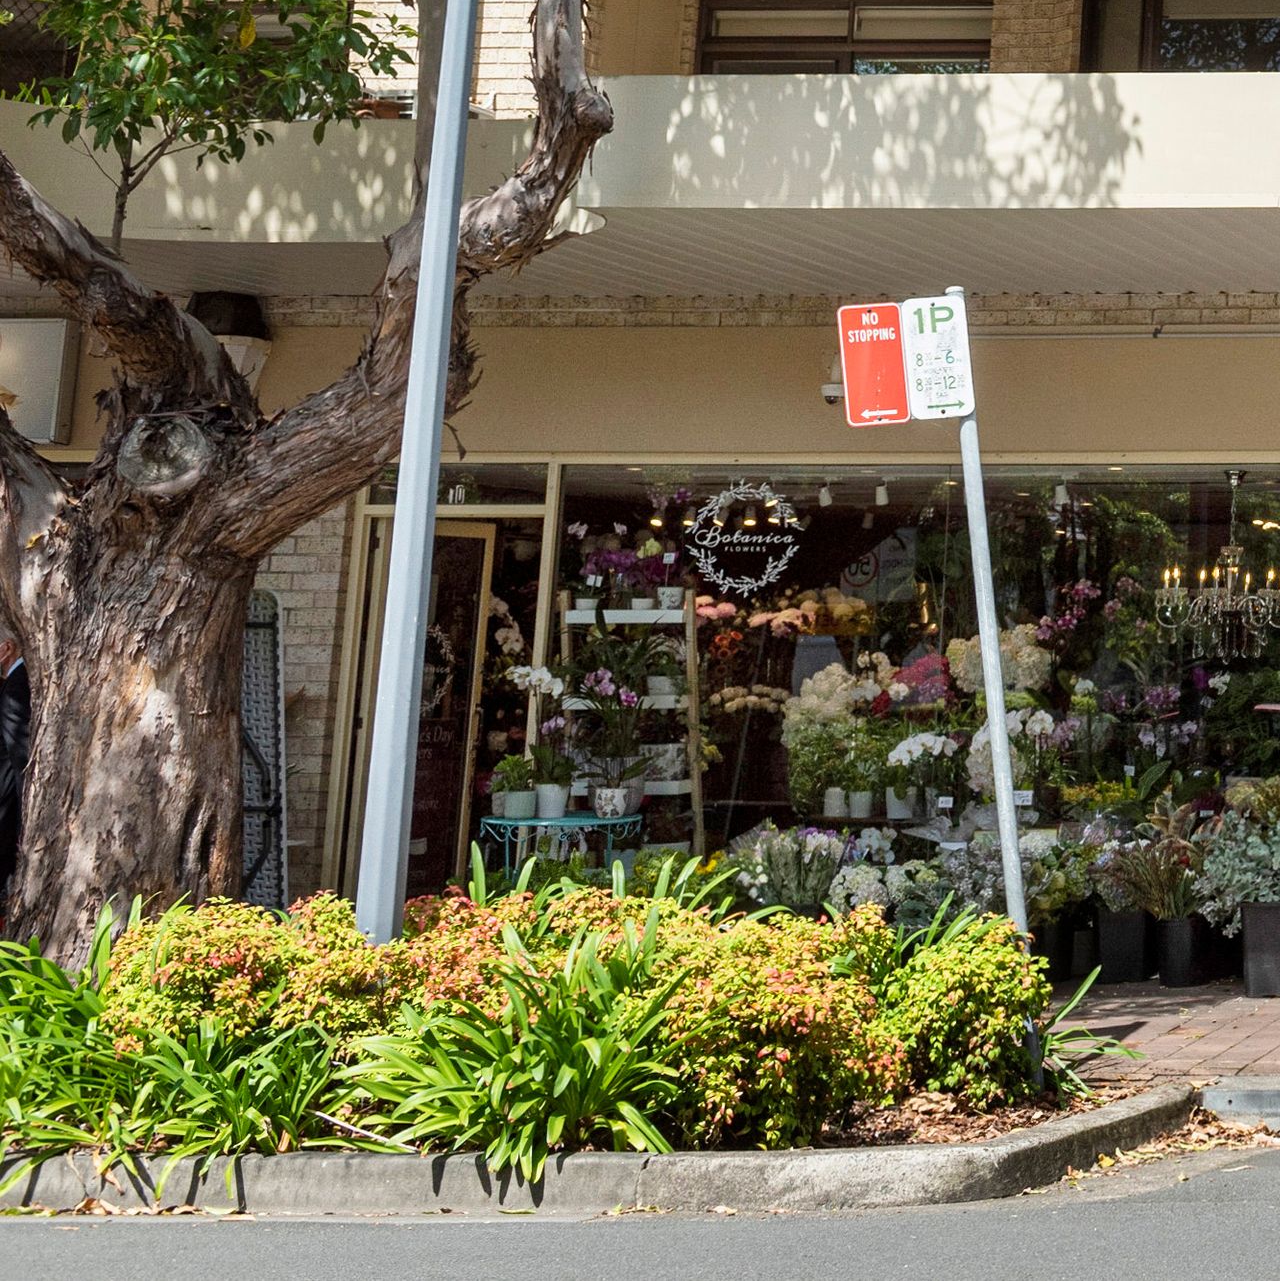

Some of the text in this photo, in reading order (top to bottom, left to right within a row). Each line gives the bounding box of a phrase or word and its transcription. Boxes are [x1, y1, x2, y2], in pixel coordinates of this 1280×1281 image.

[861, 312, 879, 325] NO
[913, 306, 954, 334] 1P
[848, 327, 896, 343] STOPPING
[695, 525, 796, 548] Botanica
